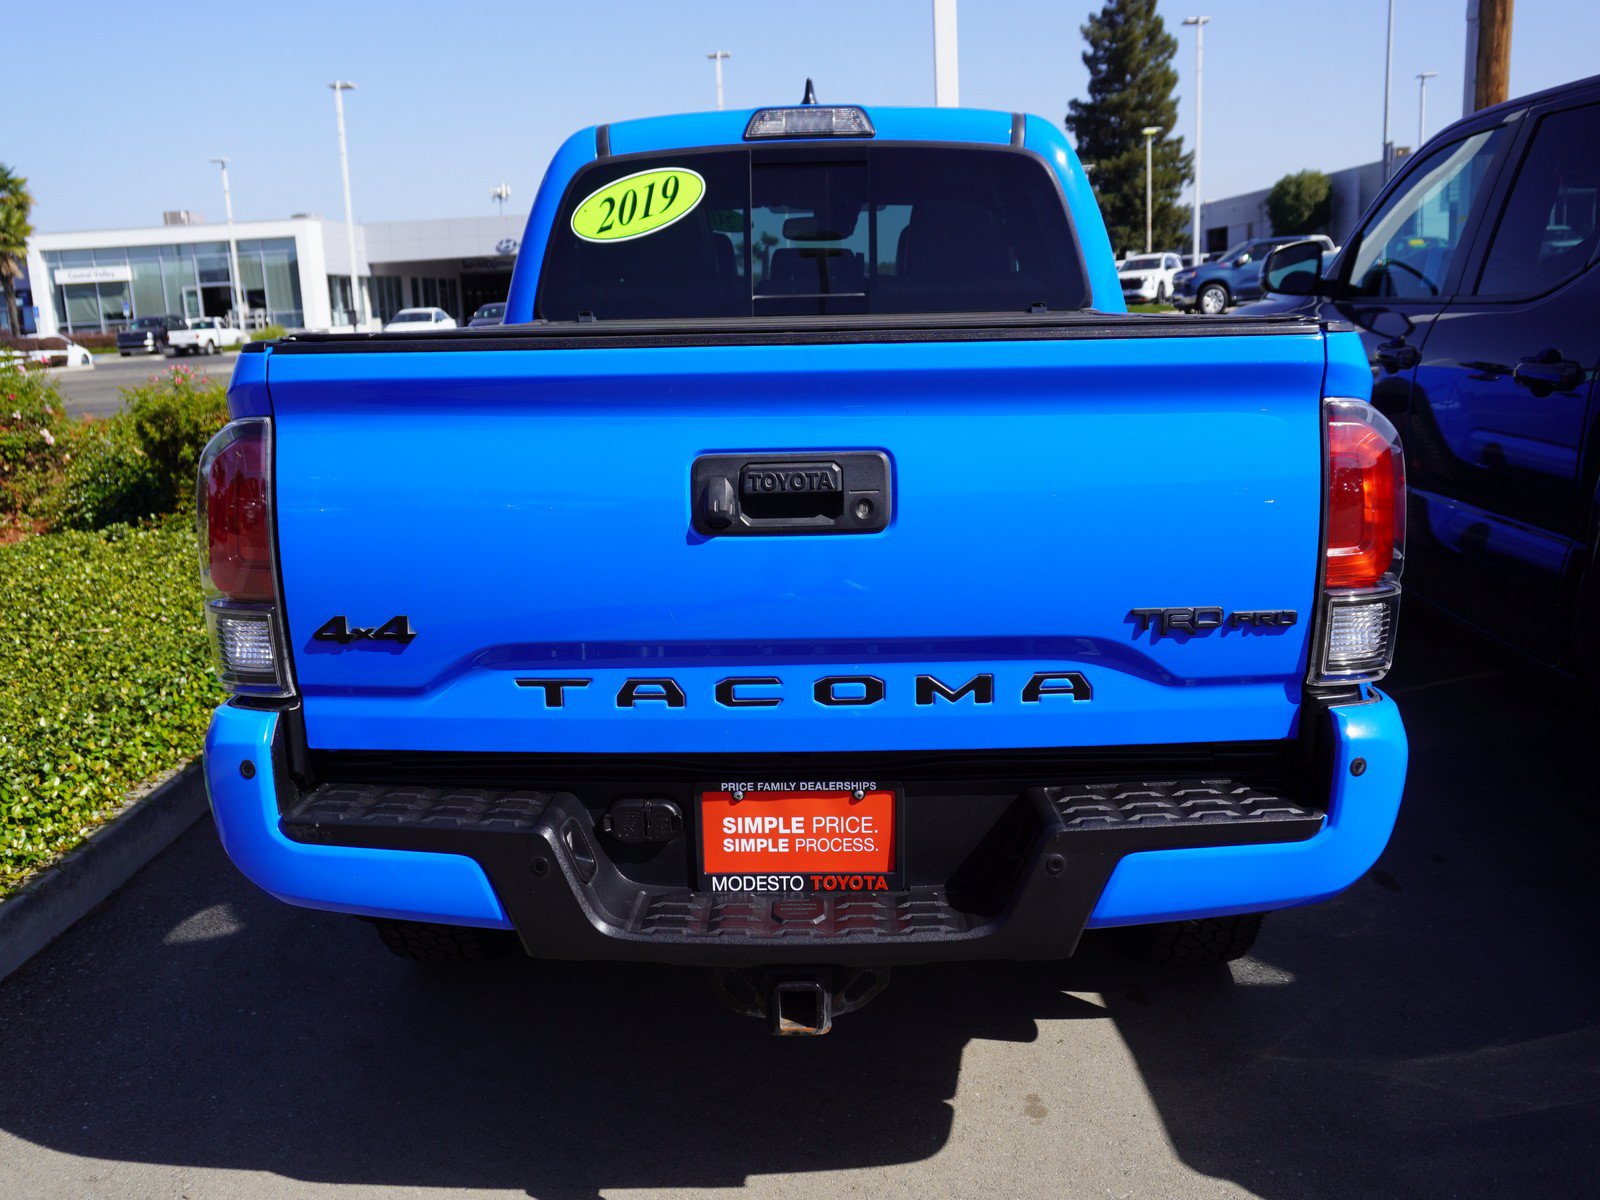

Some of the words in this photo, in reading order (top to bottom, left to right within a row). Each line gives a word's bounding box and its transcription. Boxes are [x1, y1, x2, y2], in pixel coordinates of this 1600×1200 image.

[596, 175, 679, 235] 2019
[748, 471, 836, 492] TOYOTA
[313, 615, 418, 644] 4x4
[1132, 606, 1224, 635] TRD
[1232, 610, 1298, 628] PRO
[514, 672, 1093, 709] TACOMA
[721, 782, 754, 791] PRICE
[757, 782, 796, 791] FAMILY
[800, 781, 877, 791] DEALERSHIPS
[722, 816, 805, 834] SIMPLE
[812, 816, 879, 833] PRICE.
[723, 838, 789, 852] SIMPLE
[795, 837, 879, 852] PROCESS.
[712, 875, 804, 891] MODESTO
[810, 875, 889, 890] TOYOTA
